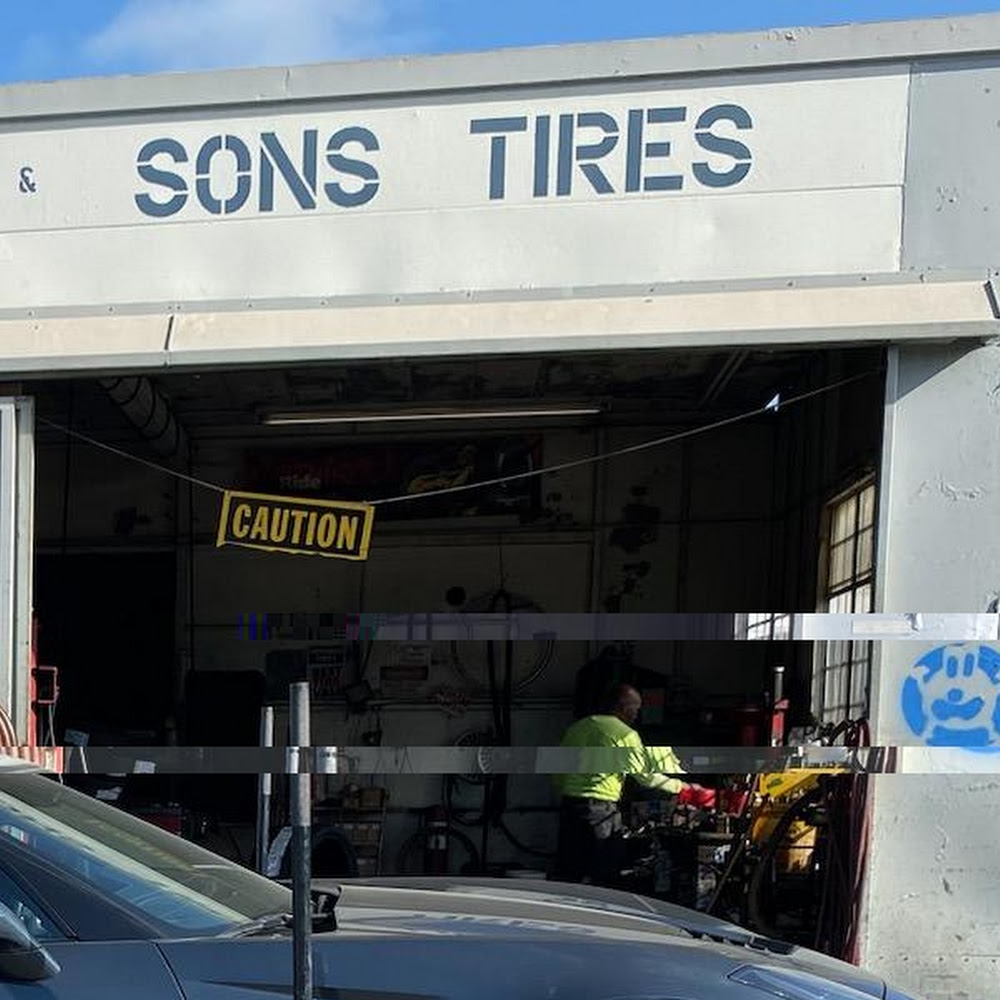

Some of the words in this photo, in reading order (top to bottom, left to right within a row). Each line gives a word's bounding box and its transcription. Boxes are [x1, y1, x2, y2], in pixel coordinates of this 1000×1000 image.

[19, 166, 37, 193] &
[135, 126, 380, 217] SONS
[470, 104, 753, 200] TIRES
[232, 504, 358, 550] CAUTION
